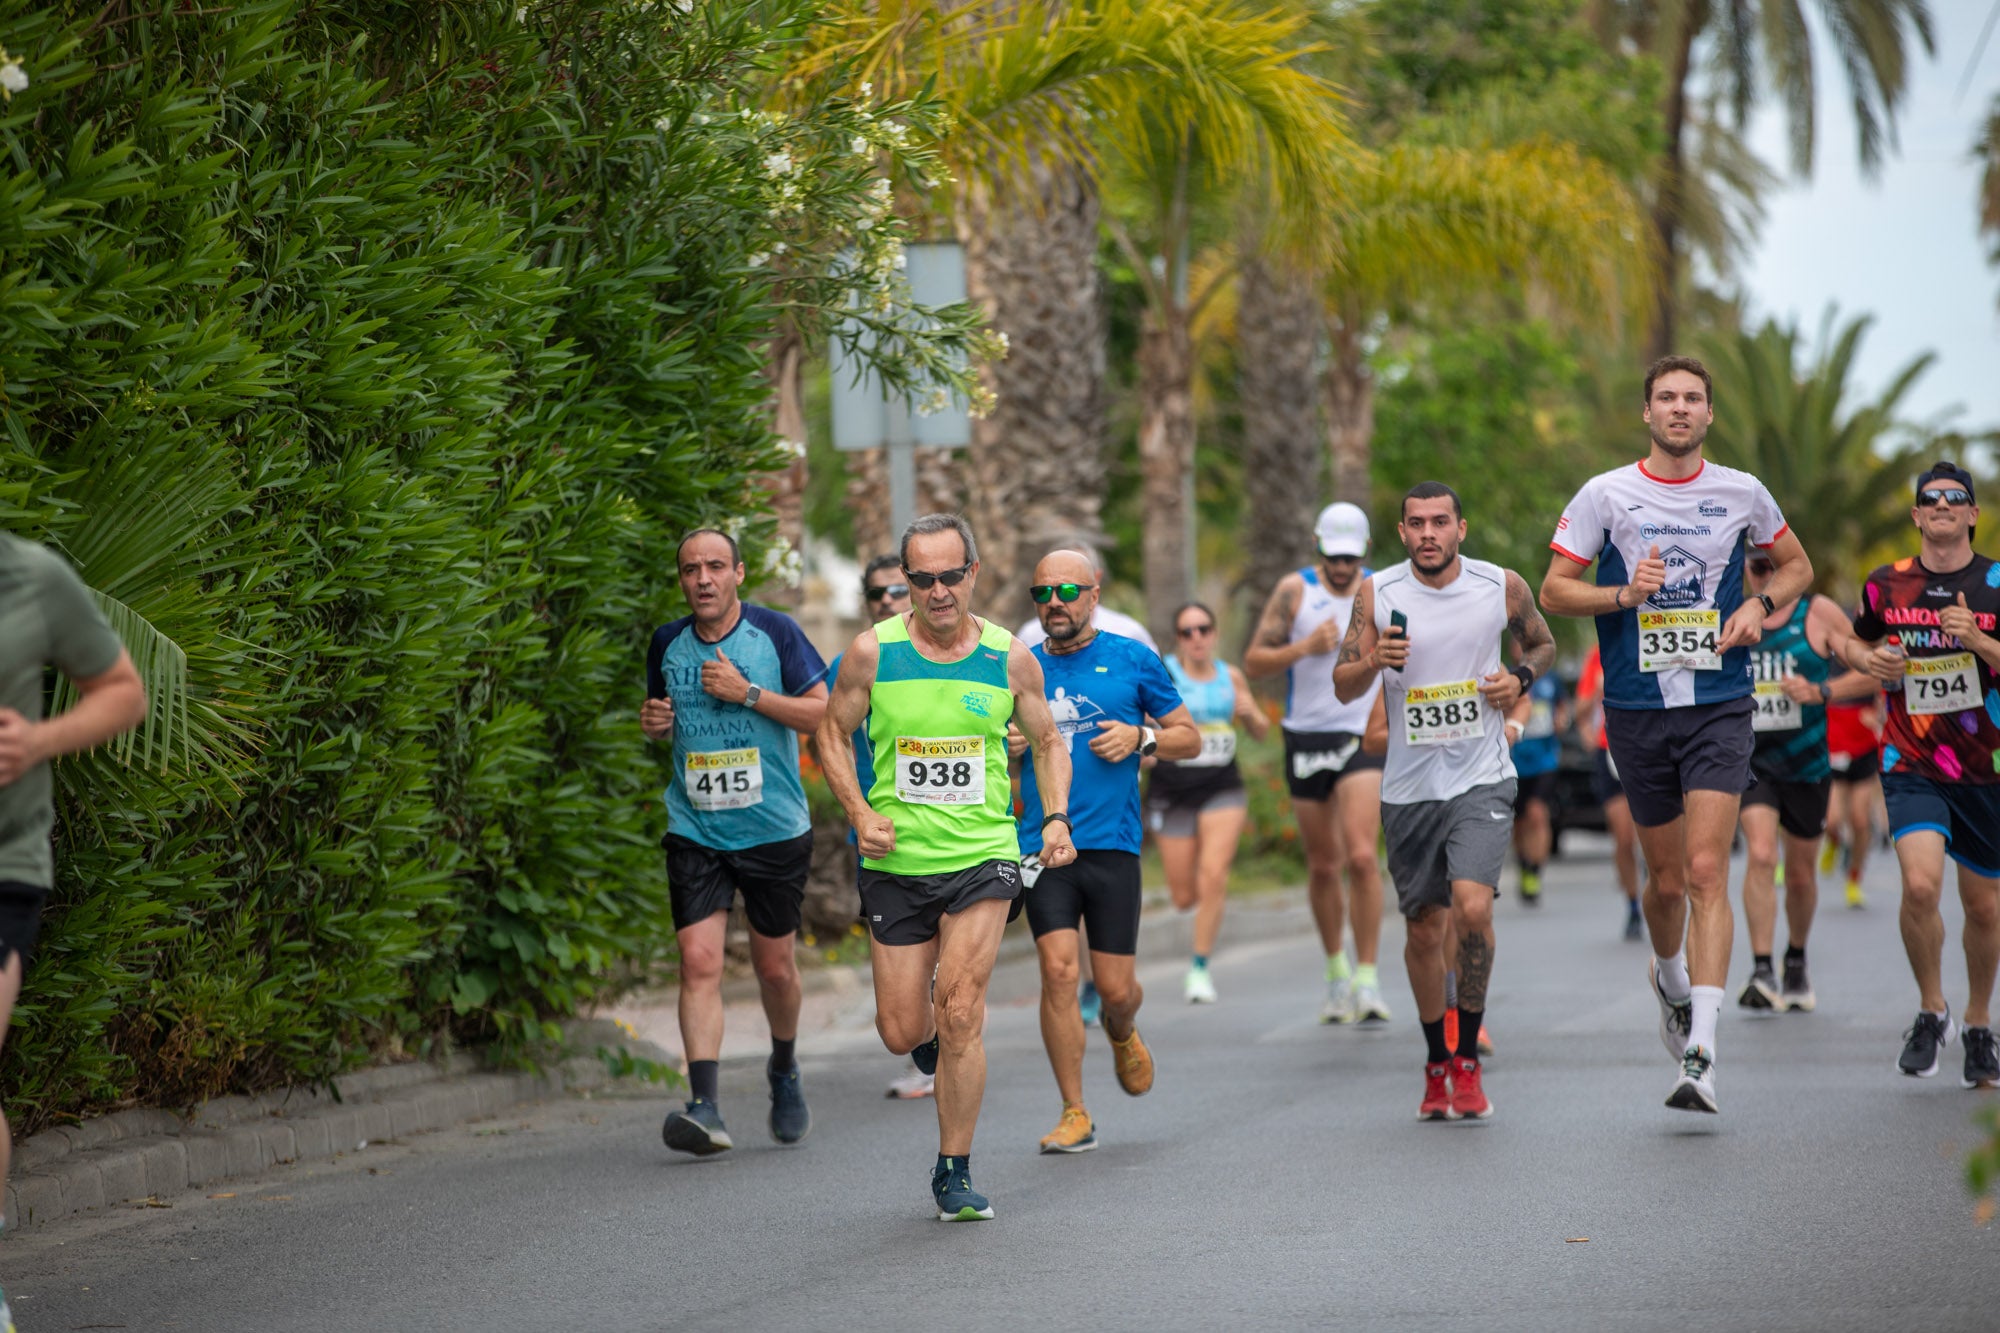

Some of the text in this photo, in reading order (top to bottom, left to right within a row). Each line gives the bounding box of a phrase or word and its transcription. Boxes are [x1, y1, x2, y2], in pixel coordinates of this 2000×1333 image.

[1643, 525, 1711, 536] mediolanum
[1664, 558, 1687, 567] 15K
[1653, 590, 1696, 600] Sevilla
[1650, 614, 1703, 625] 38 FONDO
[1643, 631, 1718, 655] 3354
[1898, 629, 1965, 649] WHĀNA
[1914, 673, 1968, 699] 794
[1413, 687, 1465, 700] 38 FONDO
[1407, 700, 1479, 728] 3383
[909, 741, 966, 755] 38 FONDO
[705, 755, 744, 767] FONDO
[909, 761, 971, 787] 938
[696, 770, 750, 795] 415
